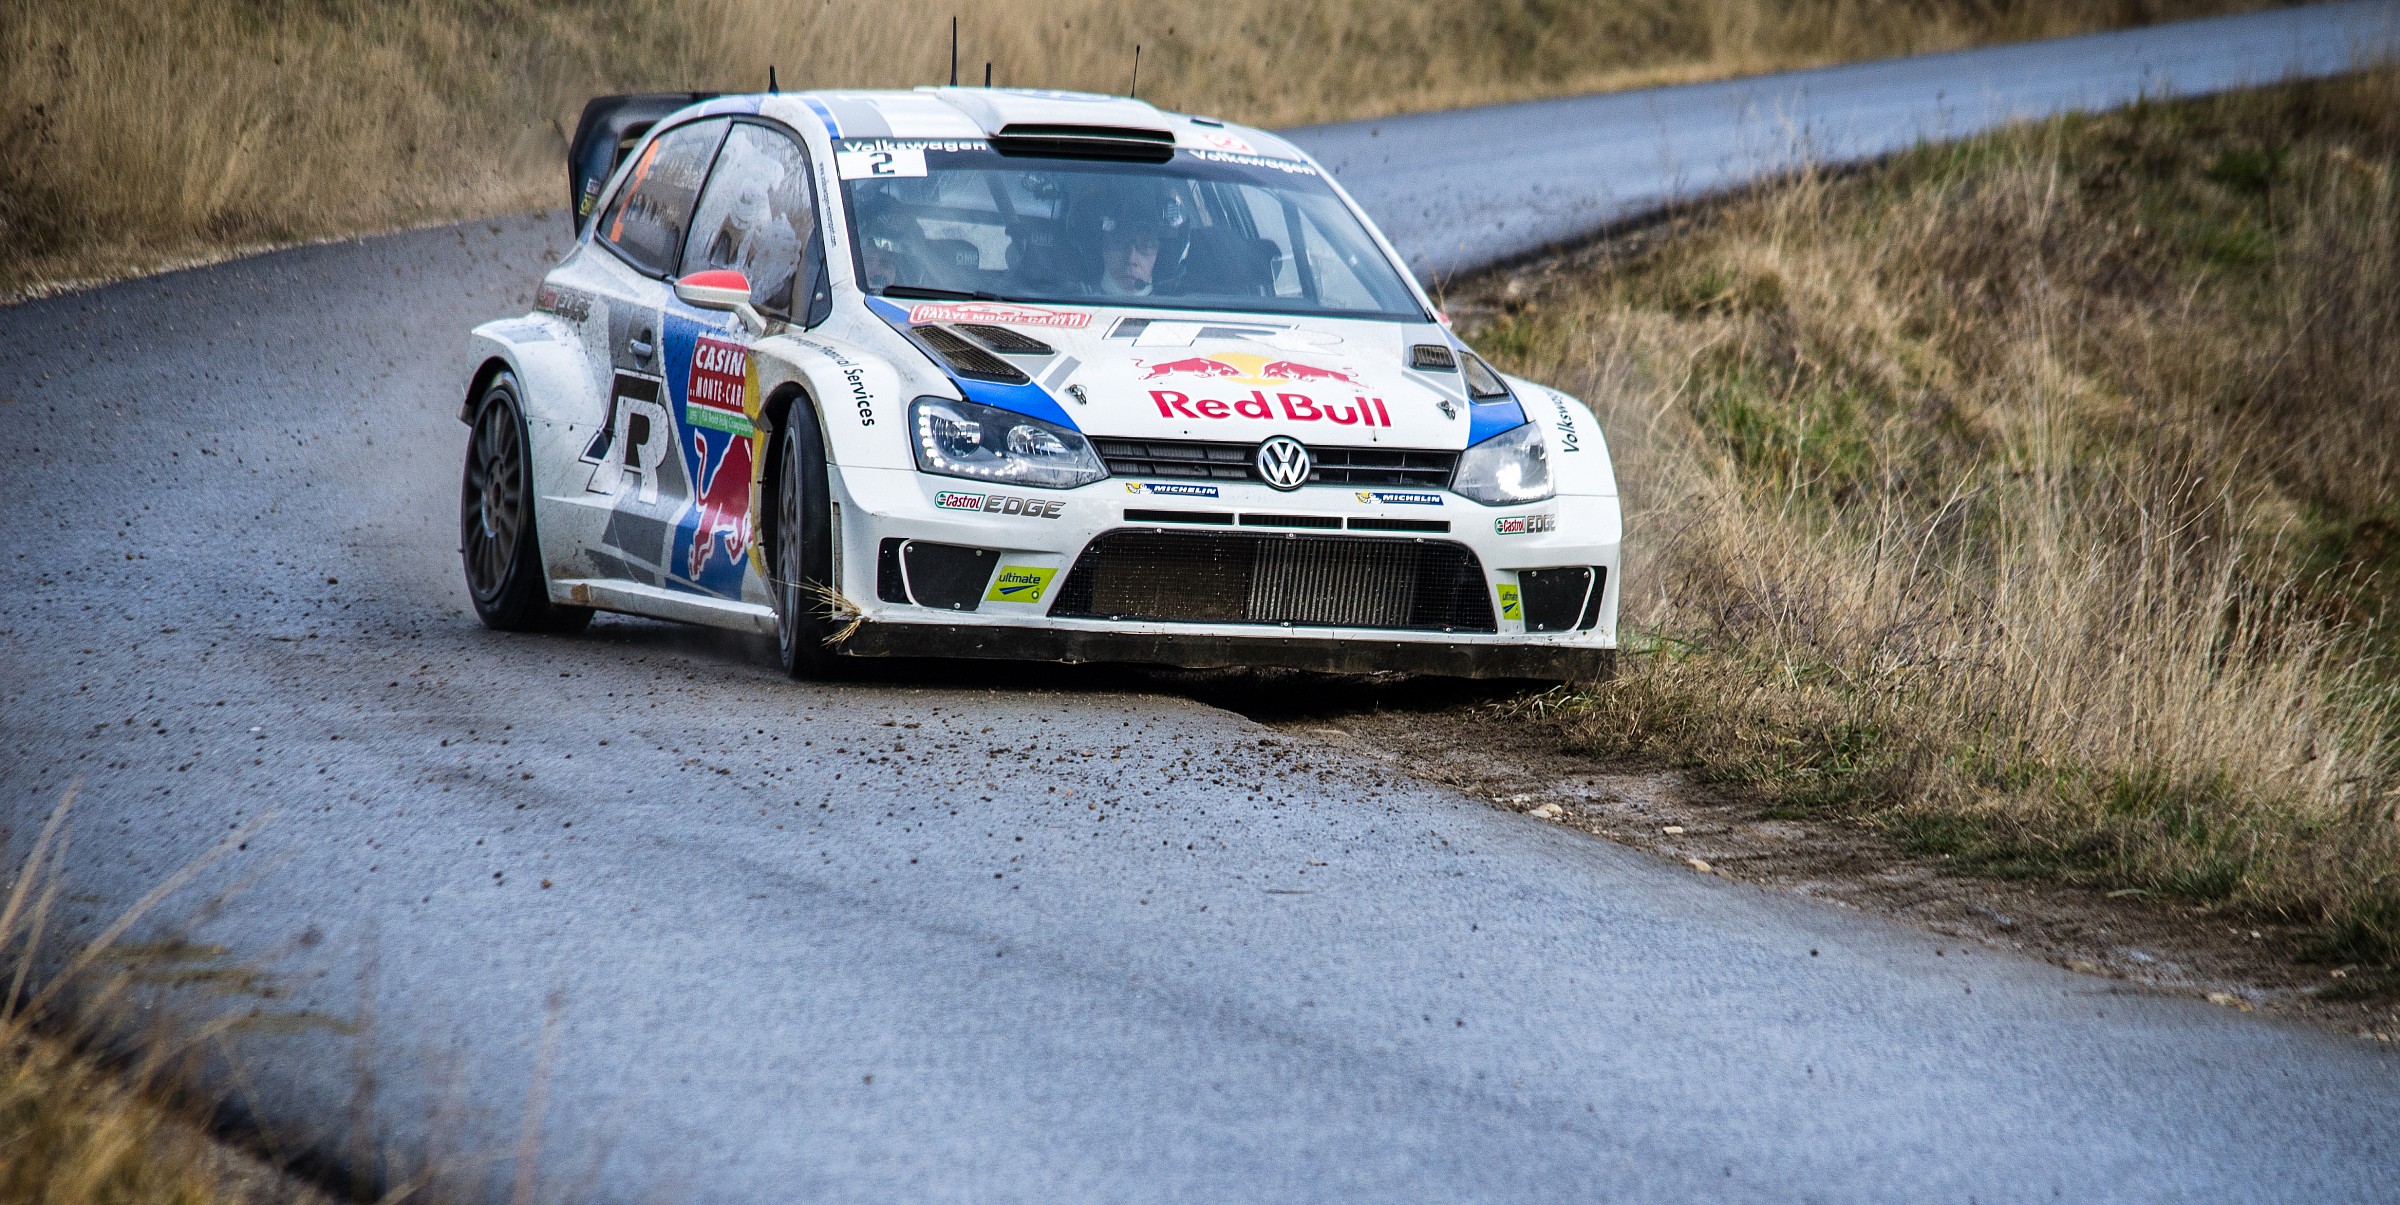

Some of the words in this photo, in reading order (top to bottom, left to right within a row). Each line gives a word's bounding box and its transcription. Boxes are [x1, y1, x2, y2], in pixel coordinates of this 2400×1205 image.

[844, 139, 987, 152] Volkswagen
[868, 152, 896, 176] 2
[1188, 150, 1317, 176] Volkswagen
[843, 368, 875, 427] Services
[1147, 389, 1275, 420] Red
[1277, 392, 1392, 428] Bull
[1543, 386, 1580, 453] Volkswa
[1152, 485, 1217, 496] MICHELIN
[1381, 493, 1442, 504] MICHELIN
[945, 493, 982, 509] Castrol
[982, 494, 1067, 520] EDGE
[1502, 518, 1526, 533] Castrol
[1526, 514, 1556, 533] EDGE
[998, 571, 1041, 586] ultimate
